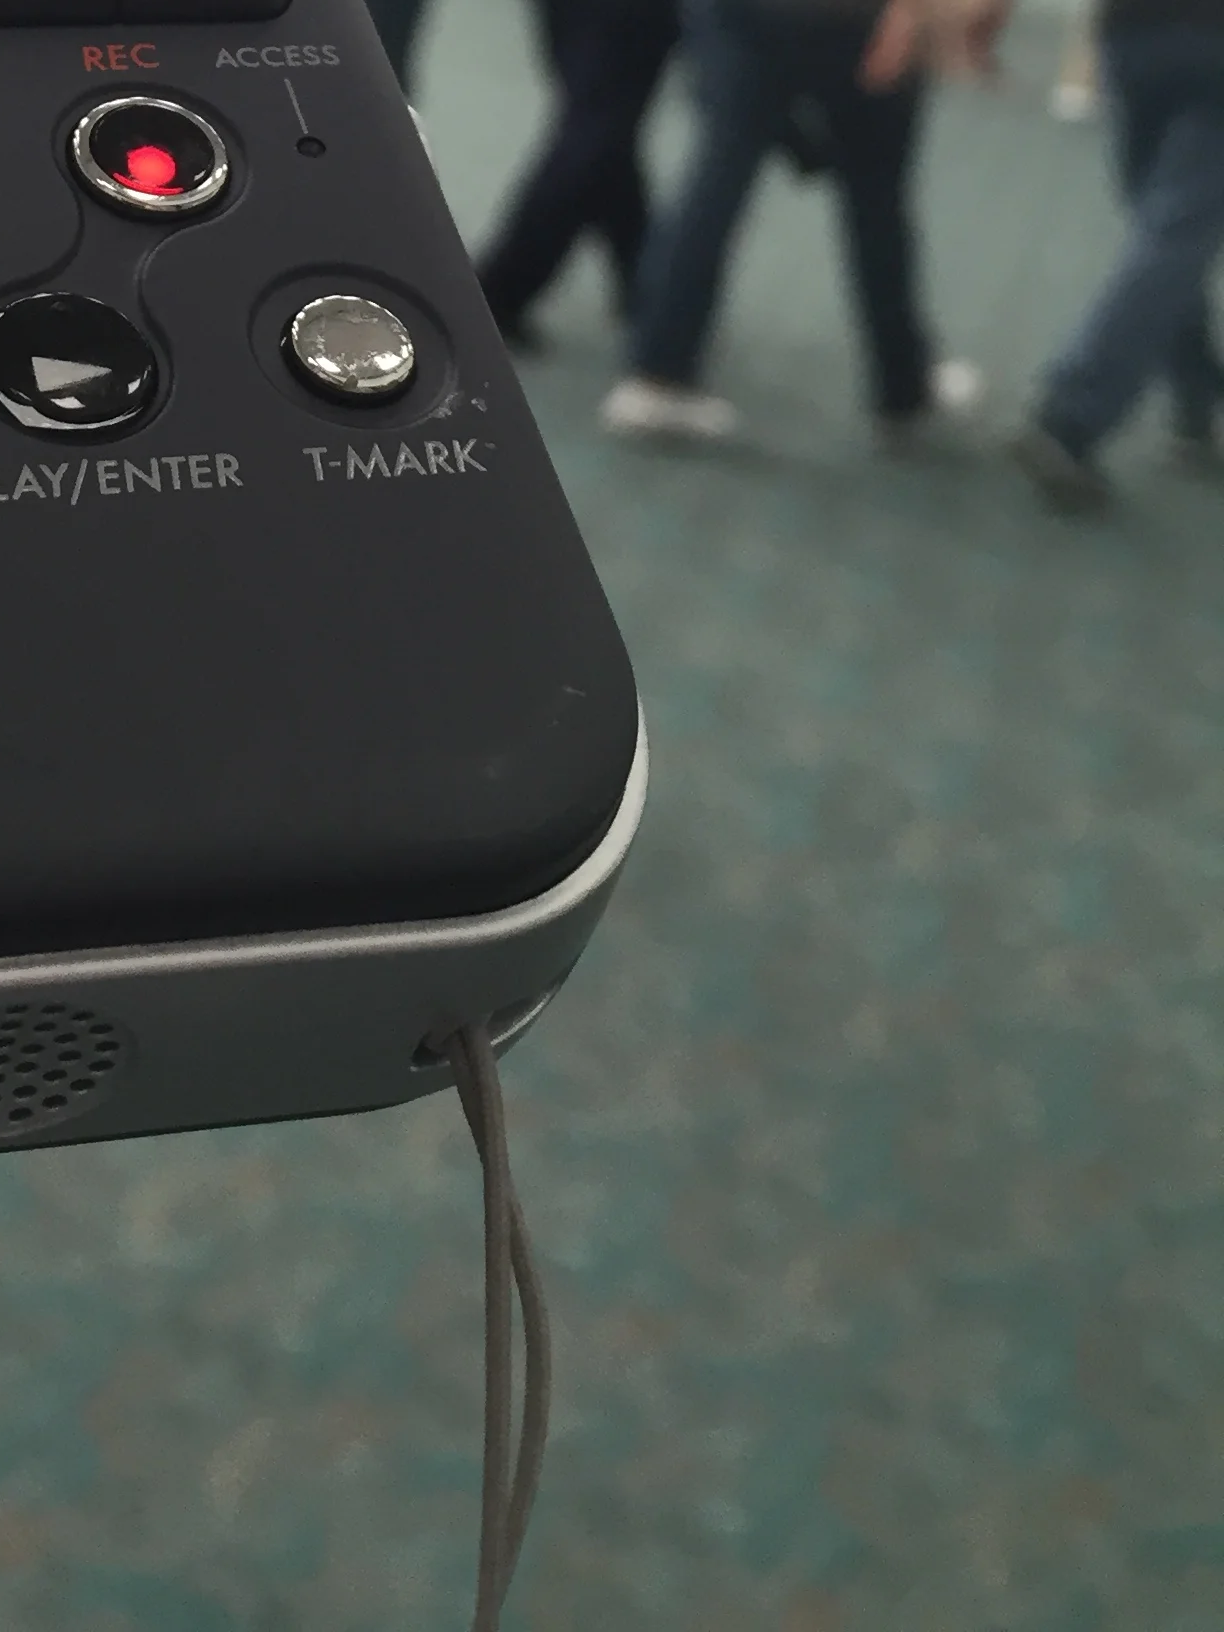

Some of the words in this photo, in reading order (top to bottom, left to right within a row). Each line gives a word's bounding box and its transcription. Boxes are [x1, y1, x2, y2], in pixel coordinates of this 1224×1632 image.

[82, 43, 160, 72] REC
[215, 44, 341, 68] ACCESS
[302, 438, 488, 482] T-MARK
